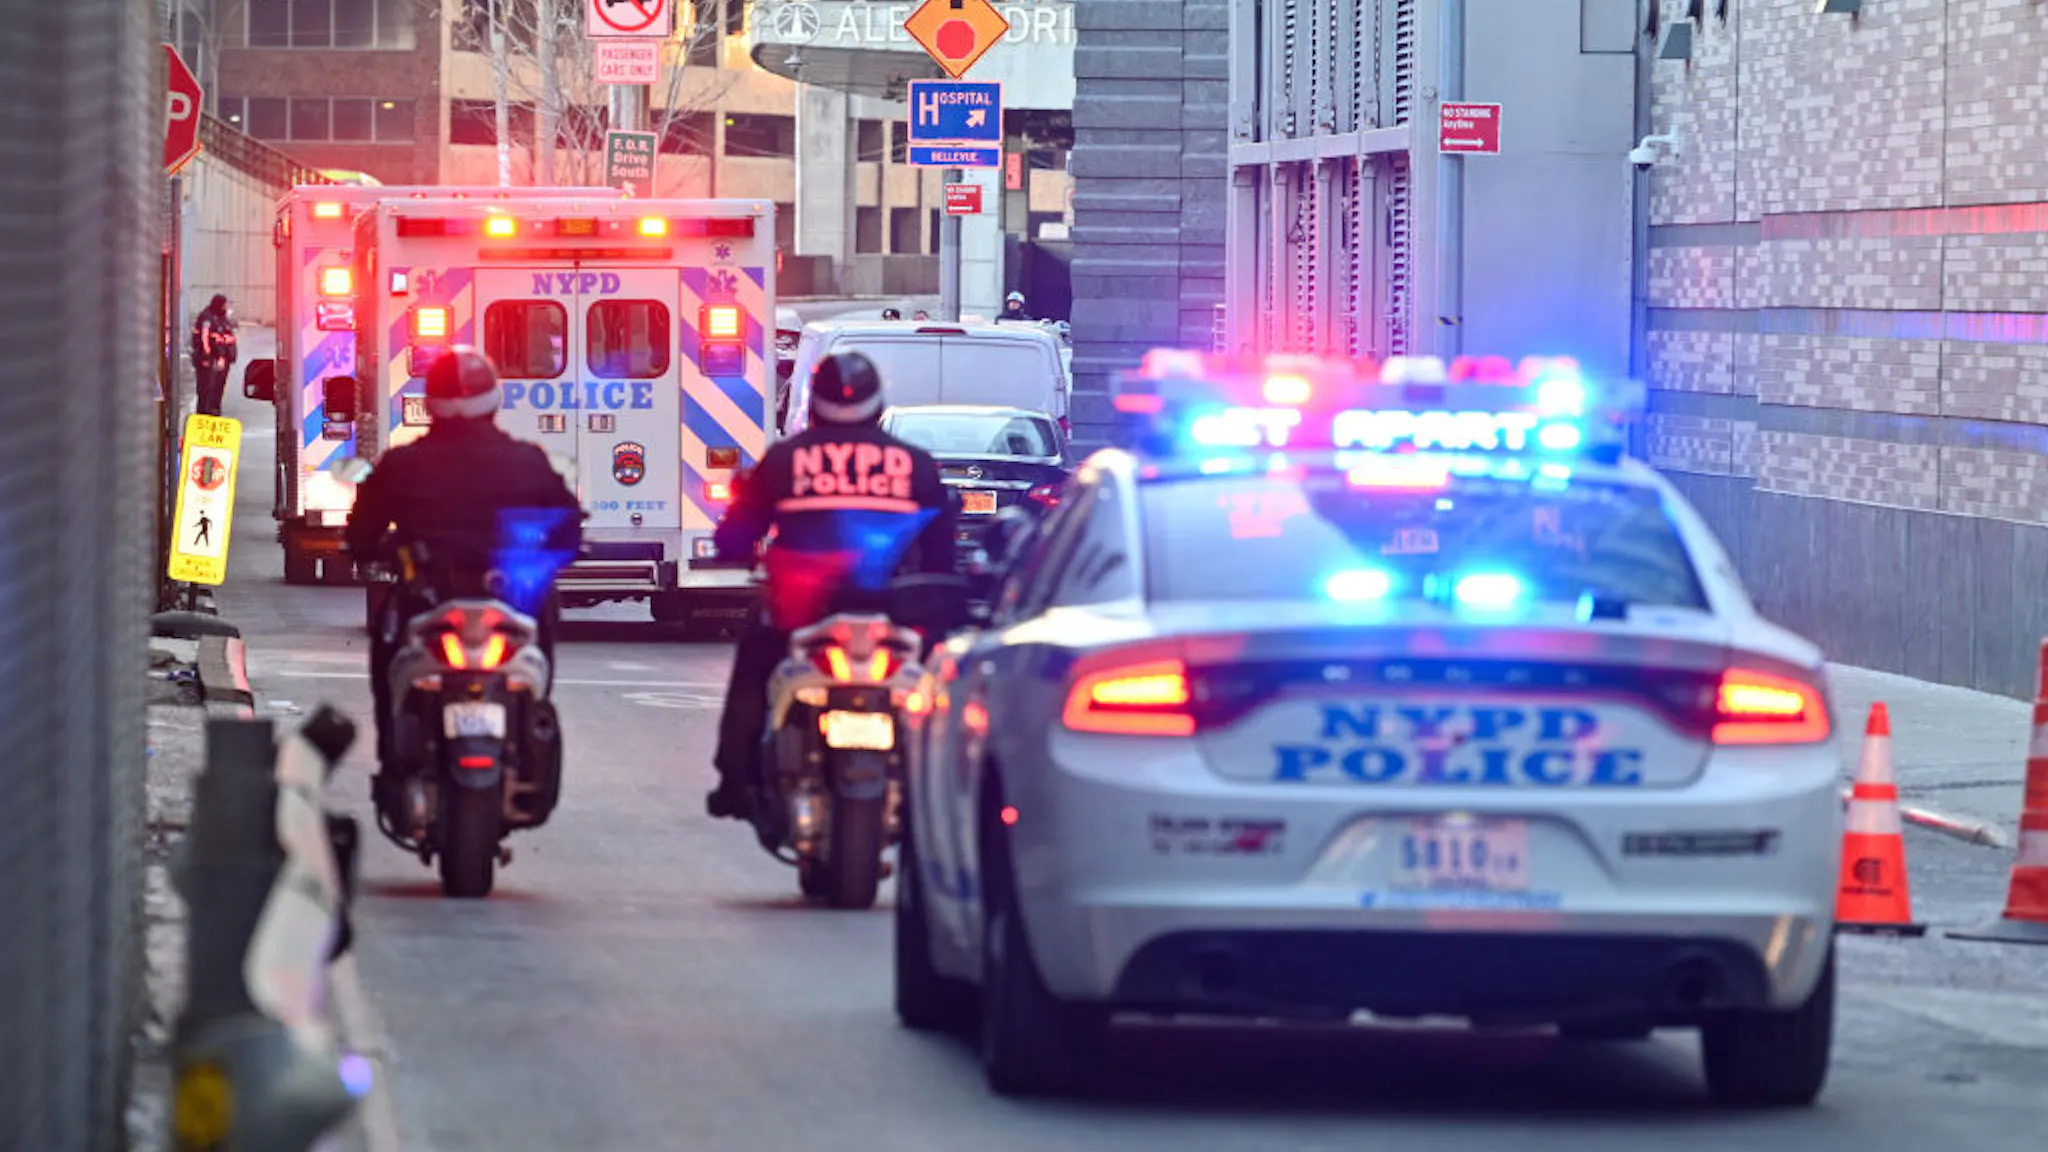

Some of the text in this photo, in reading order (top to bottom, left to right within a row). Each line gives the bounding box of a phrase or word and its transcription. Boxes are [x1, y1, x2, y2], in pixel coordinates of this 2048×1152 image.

[919, 91, 992, 126] HOSPITAL
[613, 150, 649, 166] Drive
[931, 151, 977, 163] BELLEVUE
[611, 164, 649, 178] South
[532, 272, 621, 295] NYPD
[501, 382, 654, 410] POLICE
[197, 418, 231, 434] STATE
[200, 432, 224, 445] LAW
[792, 442, 913, 478] NYPD
[792, 474, 912, 498] POLICE
[625, 500, 667, 511] FEET
[1319, 703, 1600, 741] NYPD
[1274, 744, 1643, 785] POLICE
